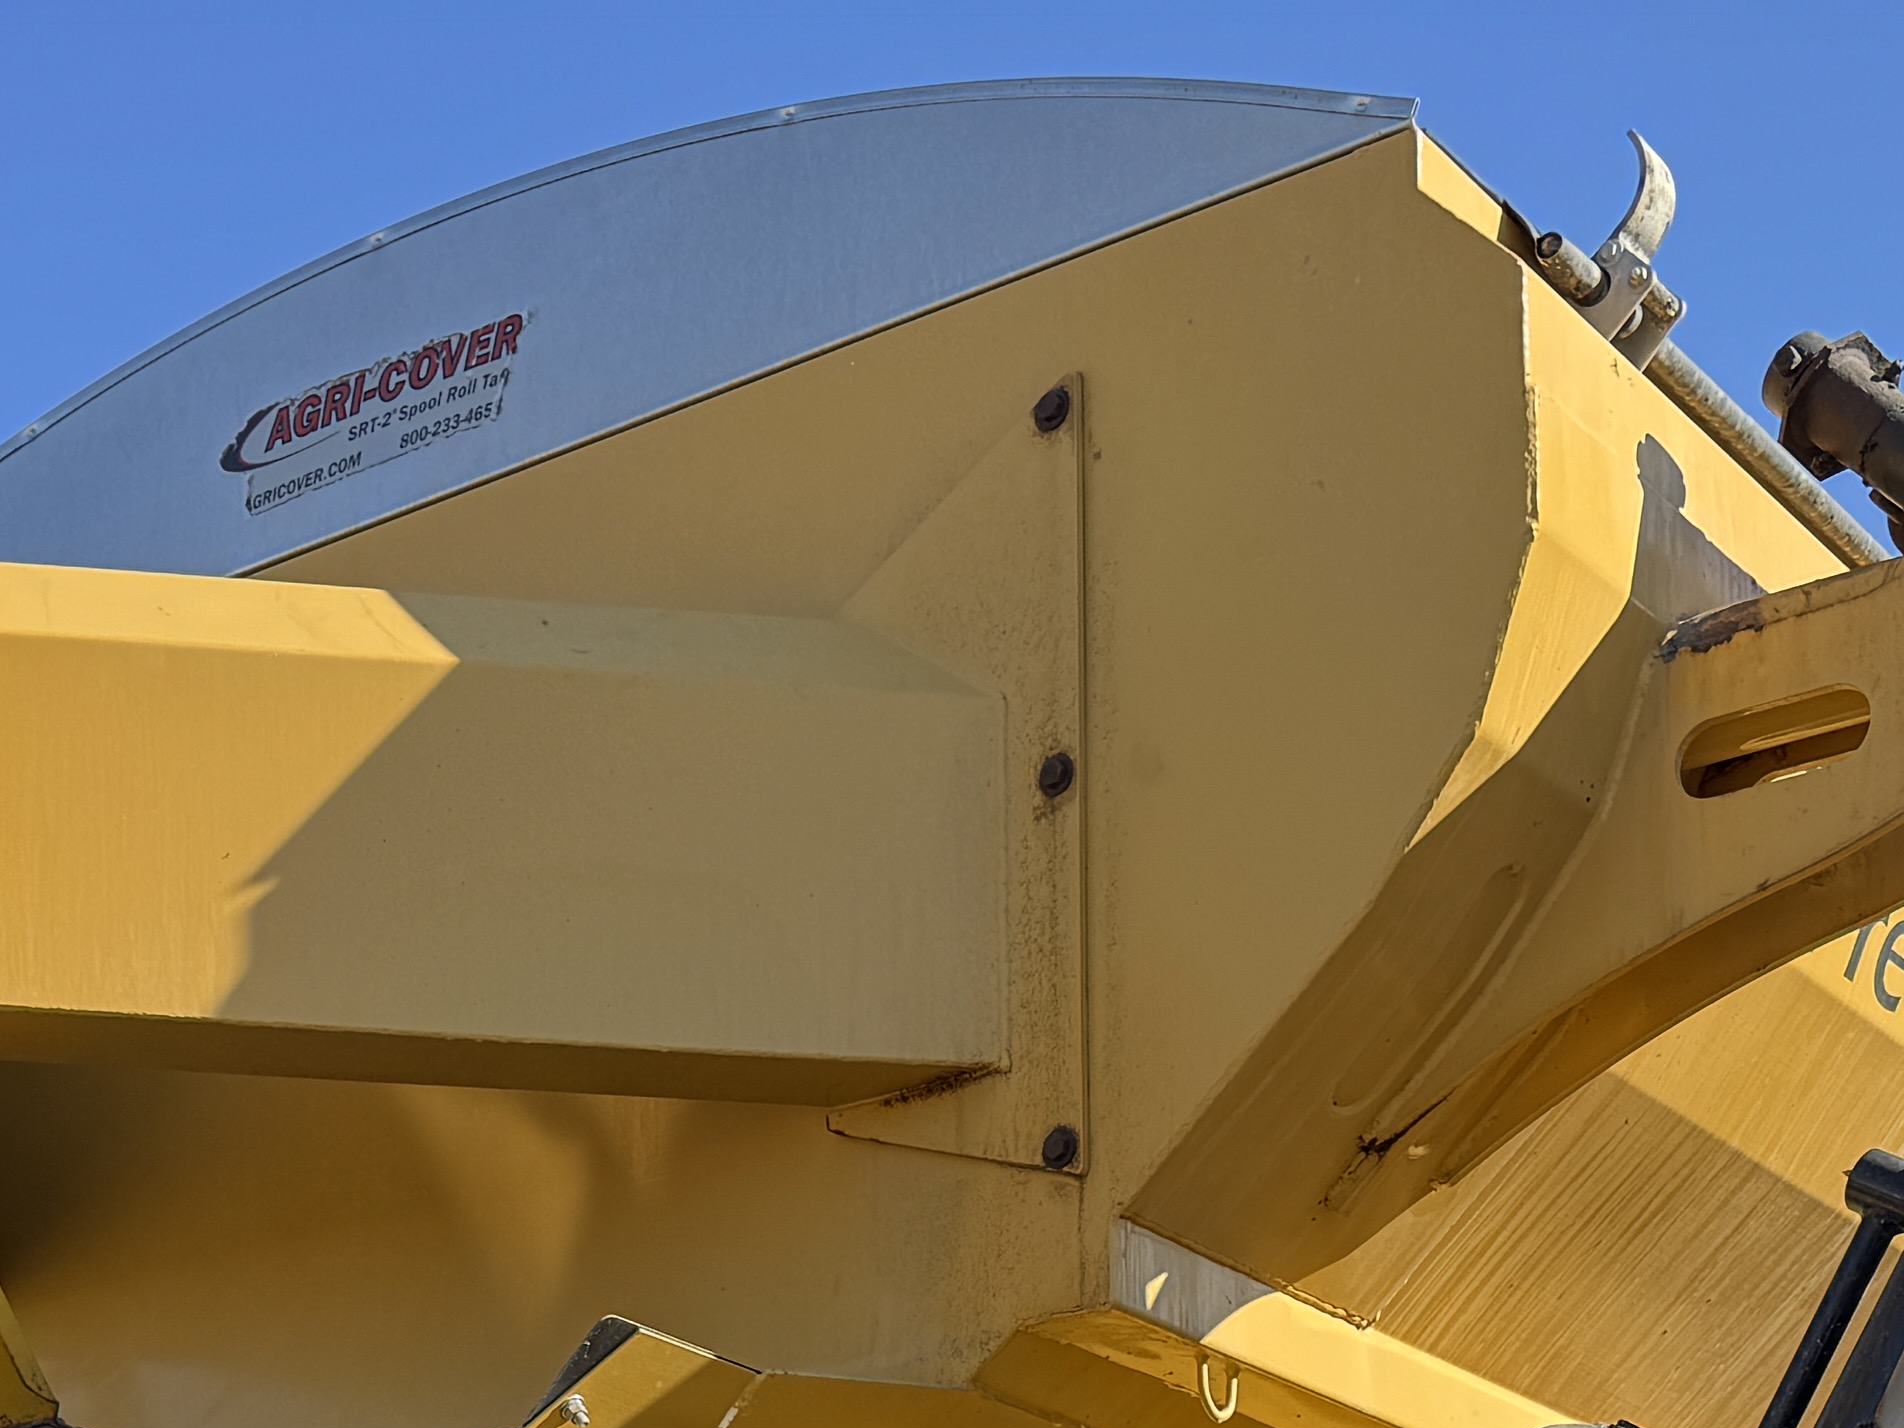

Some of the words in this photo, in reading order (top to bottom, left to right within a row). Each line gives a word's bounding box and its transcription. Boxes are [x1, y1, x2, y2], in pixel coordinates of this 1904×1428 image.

[264, 313, 524, 453] AGRI-COVER
[399, 391, 442, 422] Spool
[446, 378, 477, 404] Roll
[399, 402, 496, 449] 800-233-465
